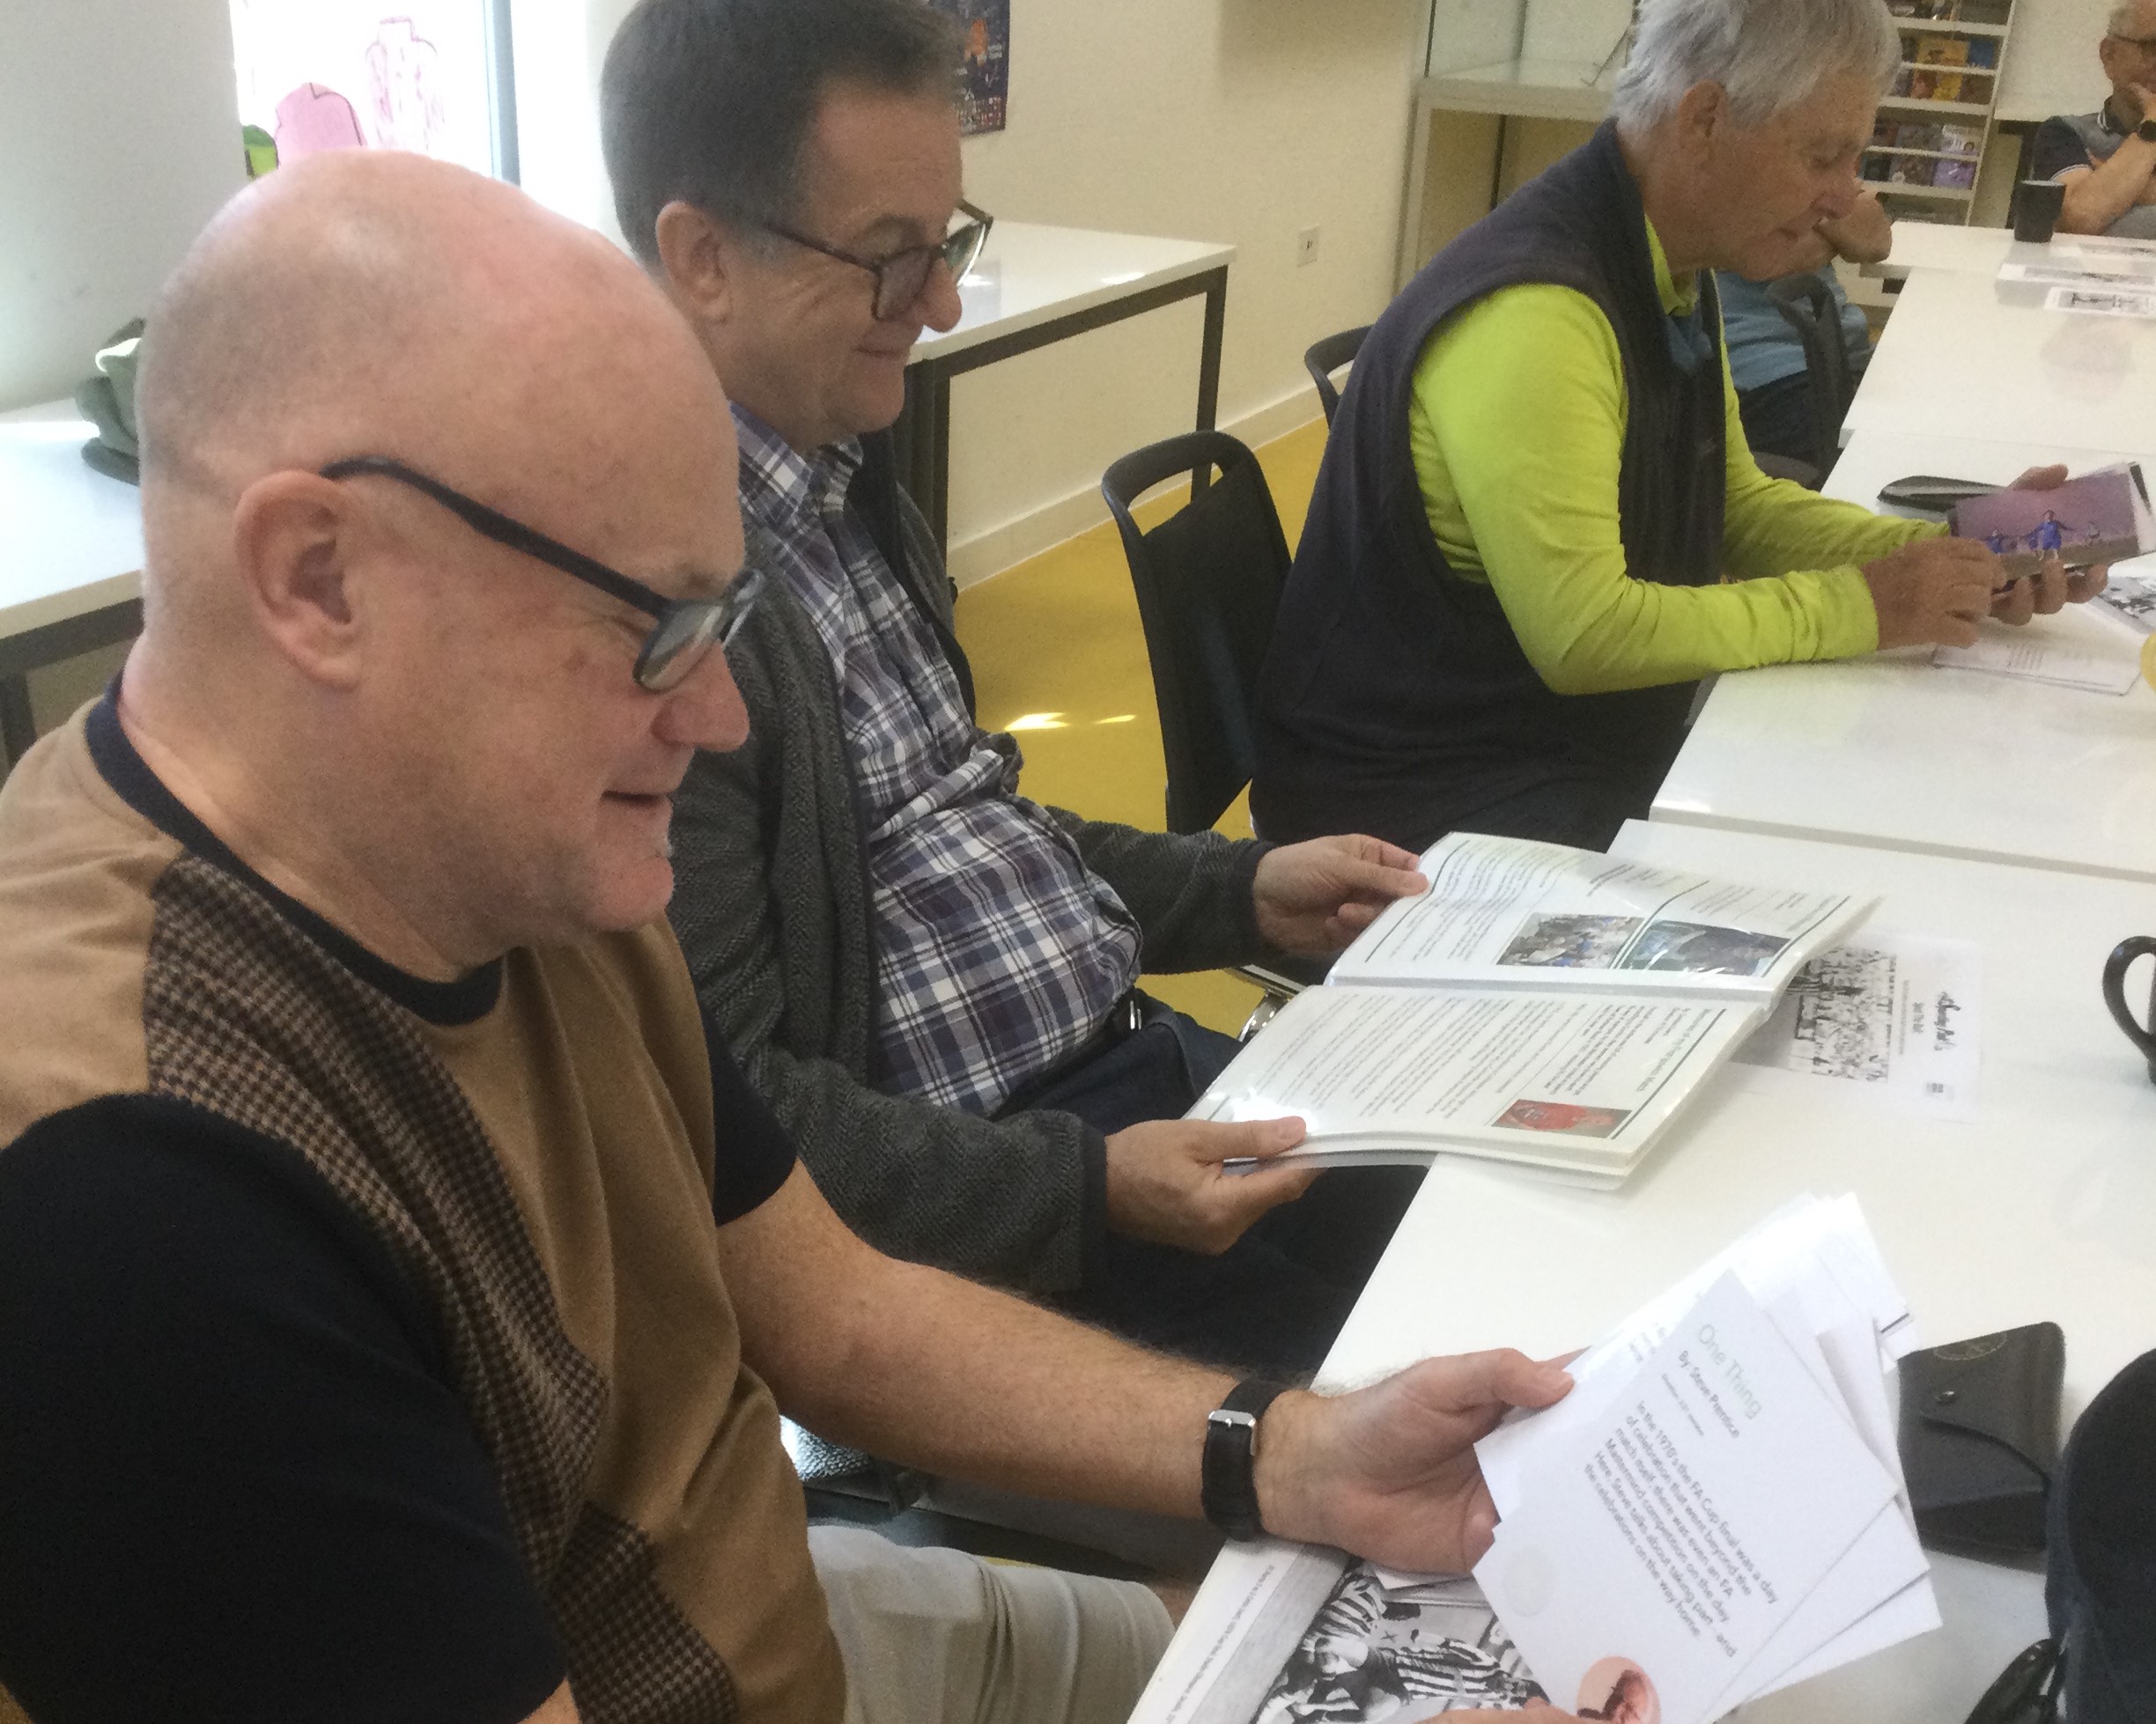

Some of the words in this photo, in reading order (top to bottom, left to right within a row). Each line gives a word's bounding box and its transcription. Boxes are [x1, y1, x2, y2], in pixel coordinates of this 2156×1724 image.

[1688, 1366, 1713, 1397] Steve
[1695, 1322, 1729, 1366] One
[1720, 1359, 1765, 1419] Thing
[1583, 1462, 1599, 1482] the
[1593, 1482, 1638, 1545] celebrations
[1634, 1544, 1648, 1561] on
[1644, 1558, 1662, 1580] the
[1658, 1580, 1677, 1603] way
[1610, 1477, 1633, 1508] Steve
[1645, 1532, 1672, 1566] about
[1667, 1565, 1696, 1602] taking
[1691, 1601, 1713, 1626] part
[1715, 1632, 1738, 1658] and
[1614, 1427, 1638, 1459] match
[1651, 1485, 1675, 1515] there
[1672, 1515, 1689, 1537] was
[1687, 1537, 1709, 1566] even
[1706, 1565, 1720, 1580] an
[1718, 1578, 1734, 1598] FA
[1625, 1414, 1639, 1427] of
[1632, 1426, 1673, 1483] celebration
[1669, 1482, 1687, 1505] that
[1684, 1505, 1707, 1532] went
[1702, 1530, 1739, 1576] beyond
[1734, 1573, 1753, 1595] the
[1640, 1499, 1687, 1564] competition
[1685, 1563, 1699, 1579] on
[1696, 1577, 1715, 1599] the
[1642, 1411, 1658, 1431] the
[1676, 1463, 1693, 1484] the
[1689, 1481, 1704, 1500] FA
[1699, 1497, 1721, 1524] Cup
[1717, 1521, 1740, 1548] final
[1735, 1548, 1754, 1572] was
[1751, 1571, 1761, 1580] a
[1758, 1580, 1779, 1604] day
